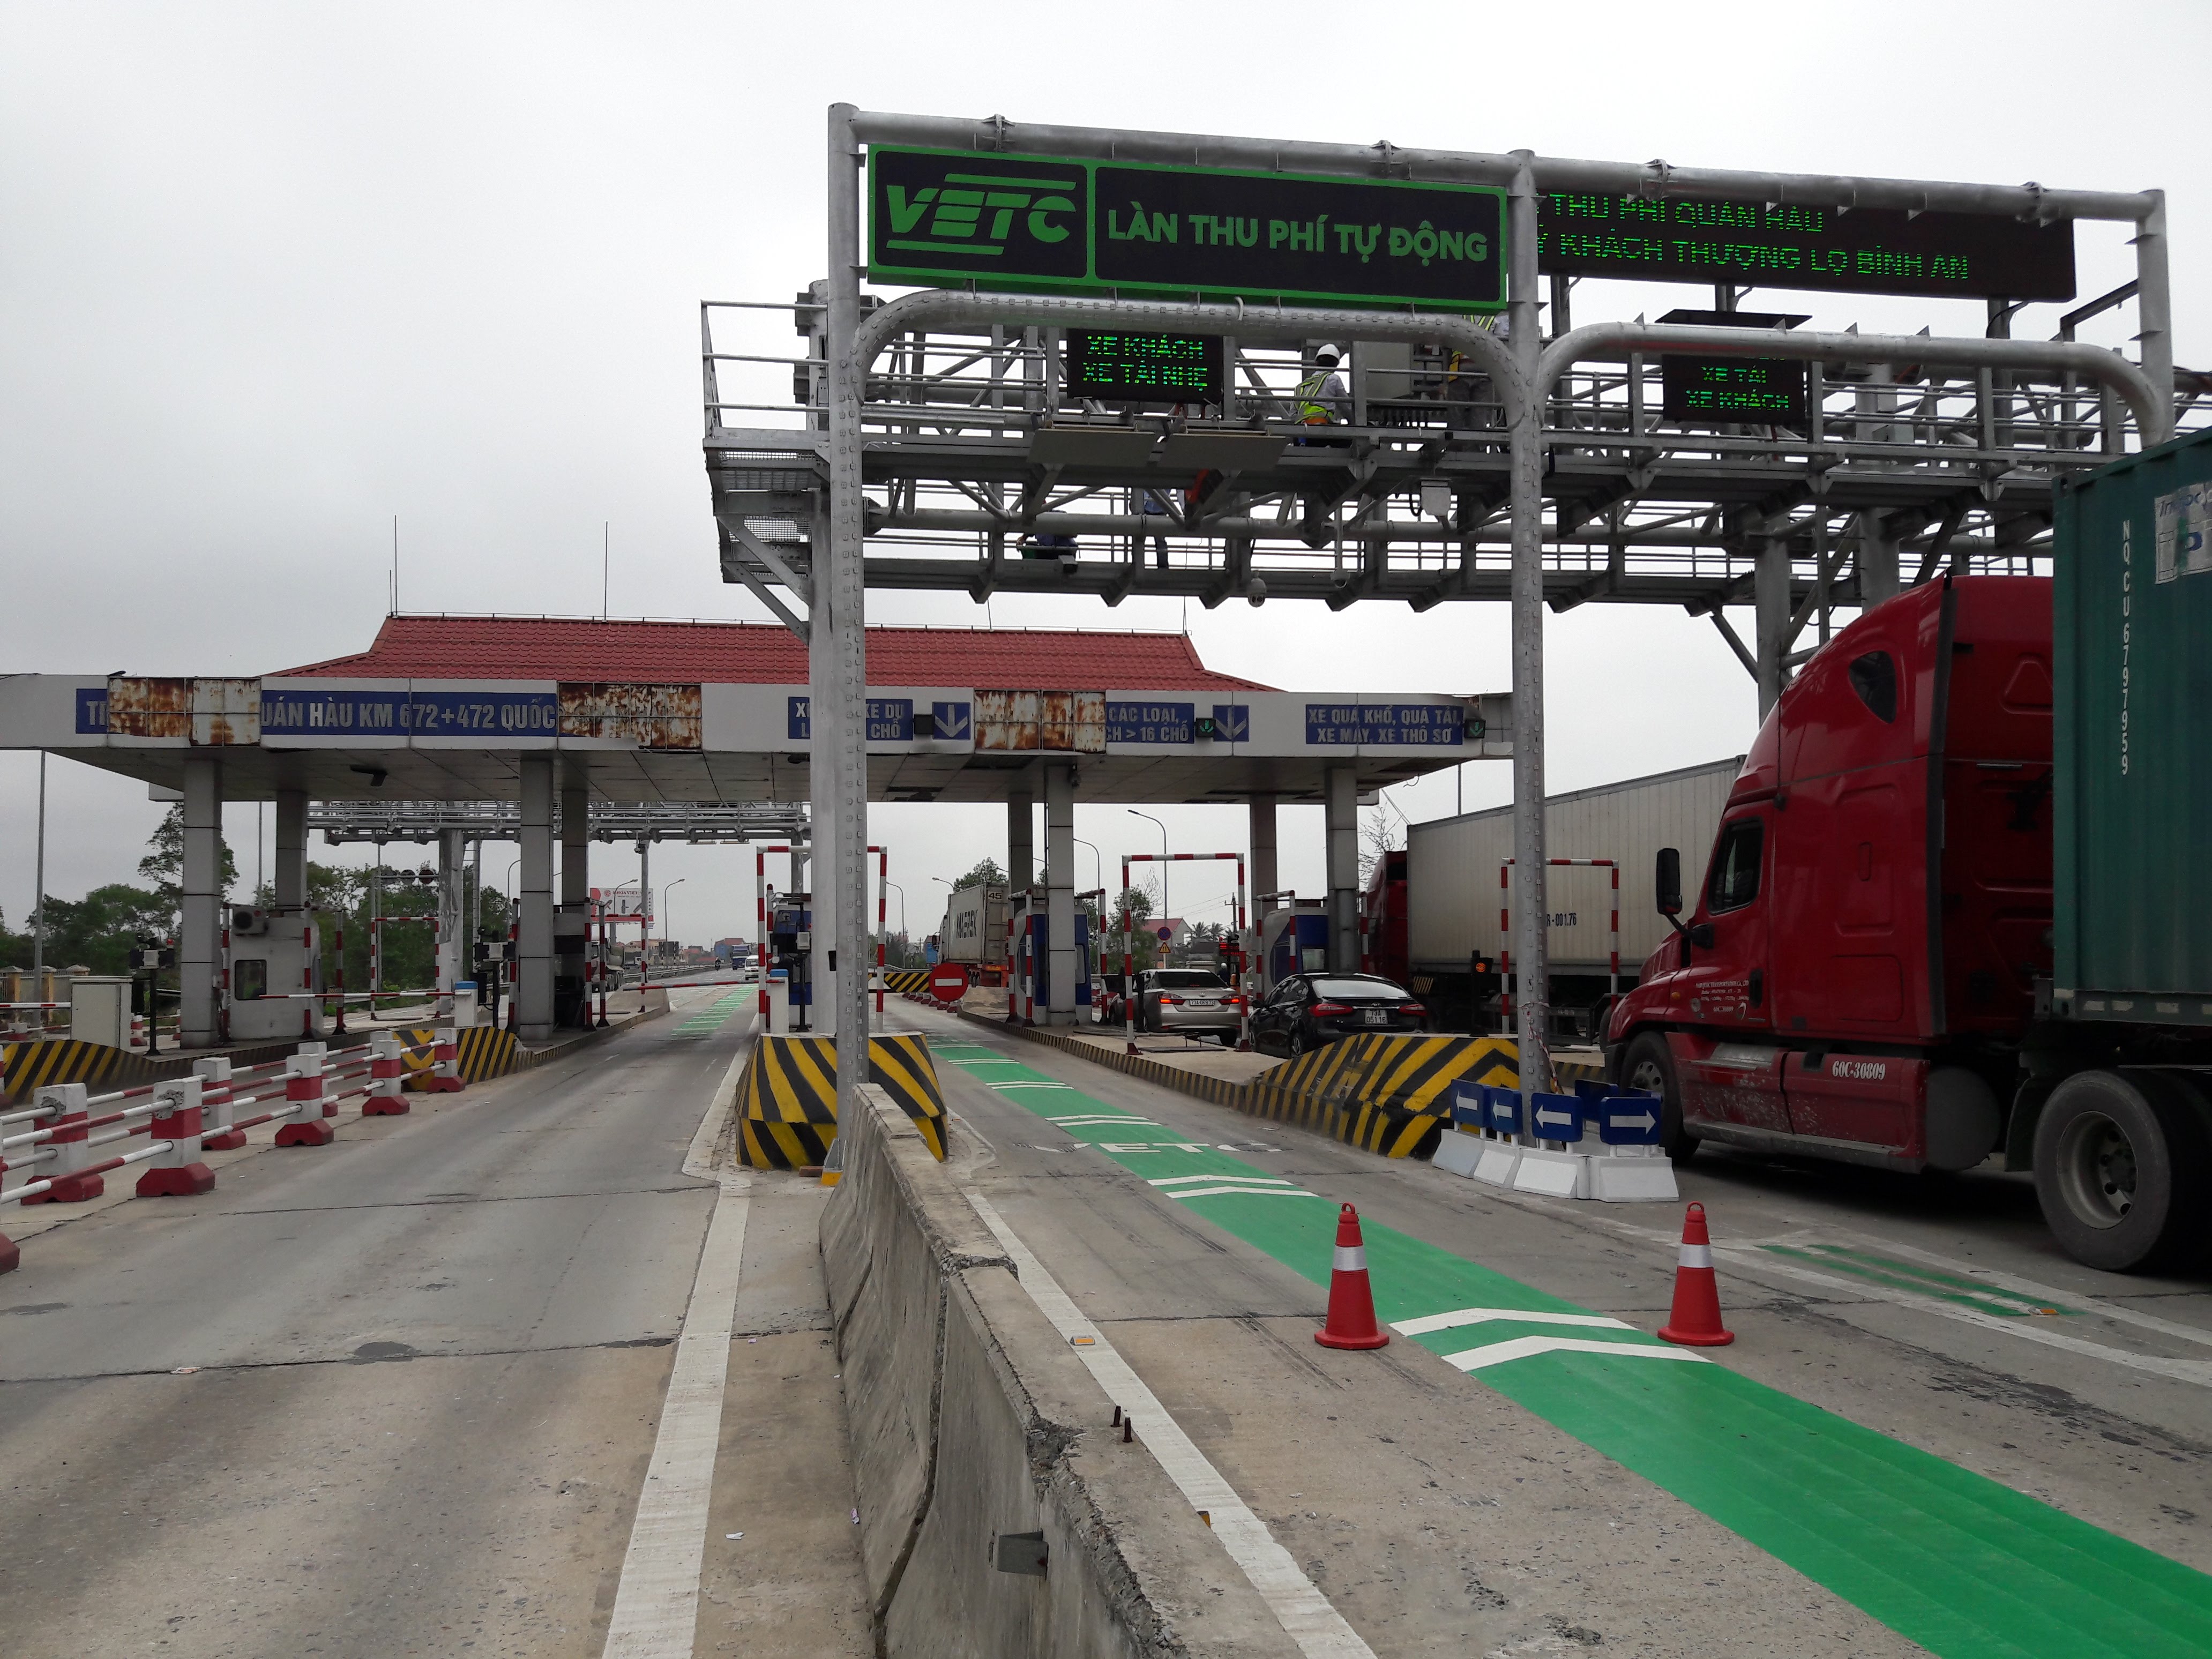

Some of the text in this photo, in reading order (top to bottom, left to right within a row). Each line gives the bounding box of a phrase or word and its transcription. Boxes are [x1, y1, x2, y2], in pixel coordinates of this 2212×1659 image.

[886, 184, 1077, 243] VETC
[1549, 194, 1608, 218] THU
[1108, 201, 1487, 266] LÀN THU PHÍ TỰ ĐỘNG
[1560, 228, 1662, 260] KHÁCH
[1087, 335, 1117, 355] XE
[1082, 362, 1113, 382] XE
[1686, 390, 1713, 408] XE
[310, 697, 353, 727] HÀU
[360, 704, 392, 728] KM
[400, 704, 495, 728] 672+472
[501, 697, 556, 731] QUỐC
[1309, 709, 1326, 723] XE
[1401, 707, 1429, 725] QUÁ
[1140, 727, 1155, 742] 16
[1318, 728, 1335, 742] XE
[1378, 729, 1395, 743] XE
[1401, 725, 1428, 743] THÔ
[1833, 1060, 1886, 1080] 60C-30809
